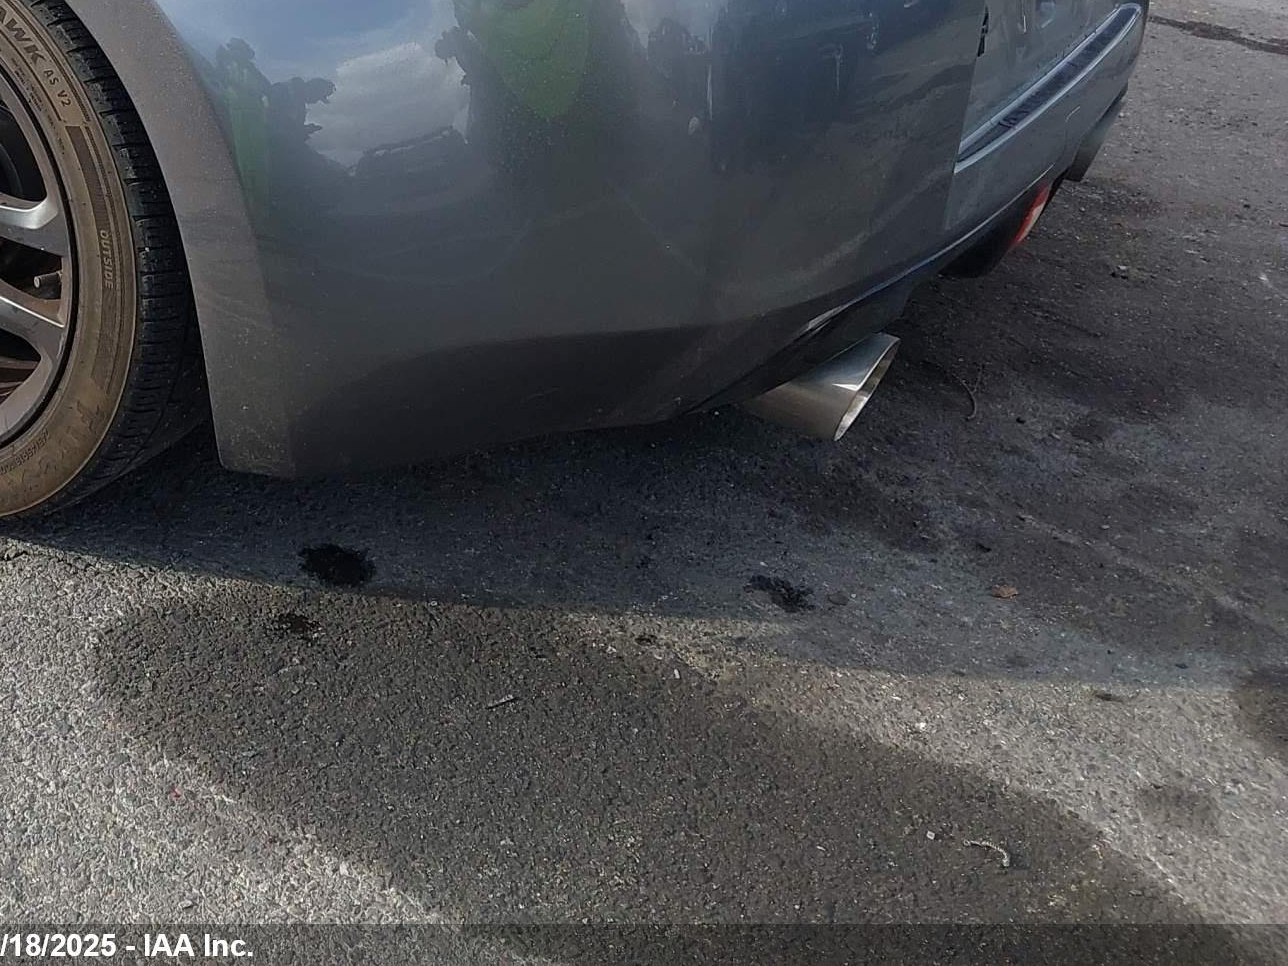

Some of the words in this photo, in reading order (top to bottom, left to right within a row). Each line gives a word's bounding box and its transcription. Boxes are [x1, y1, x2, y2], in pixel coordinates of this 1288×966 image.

[43, 68, 60, 86] AS
[57, 89, 73, 107] V2
[99, 229, 114, 290] OUTSIDE
